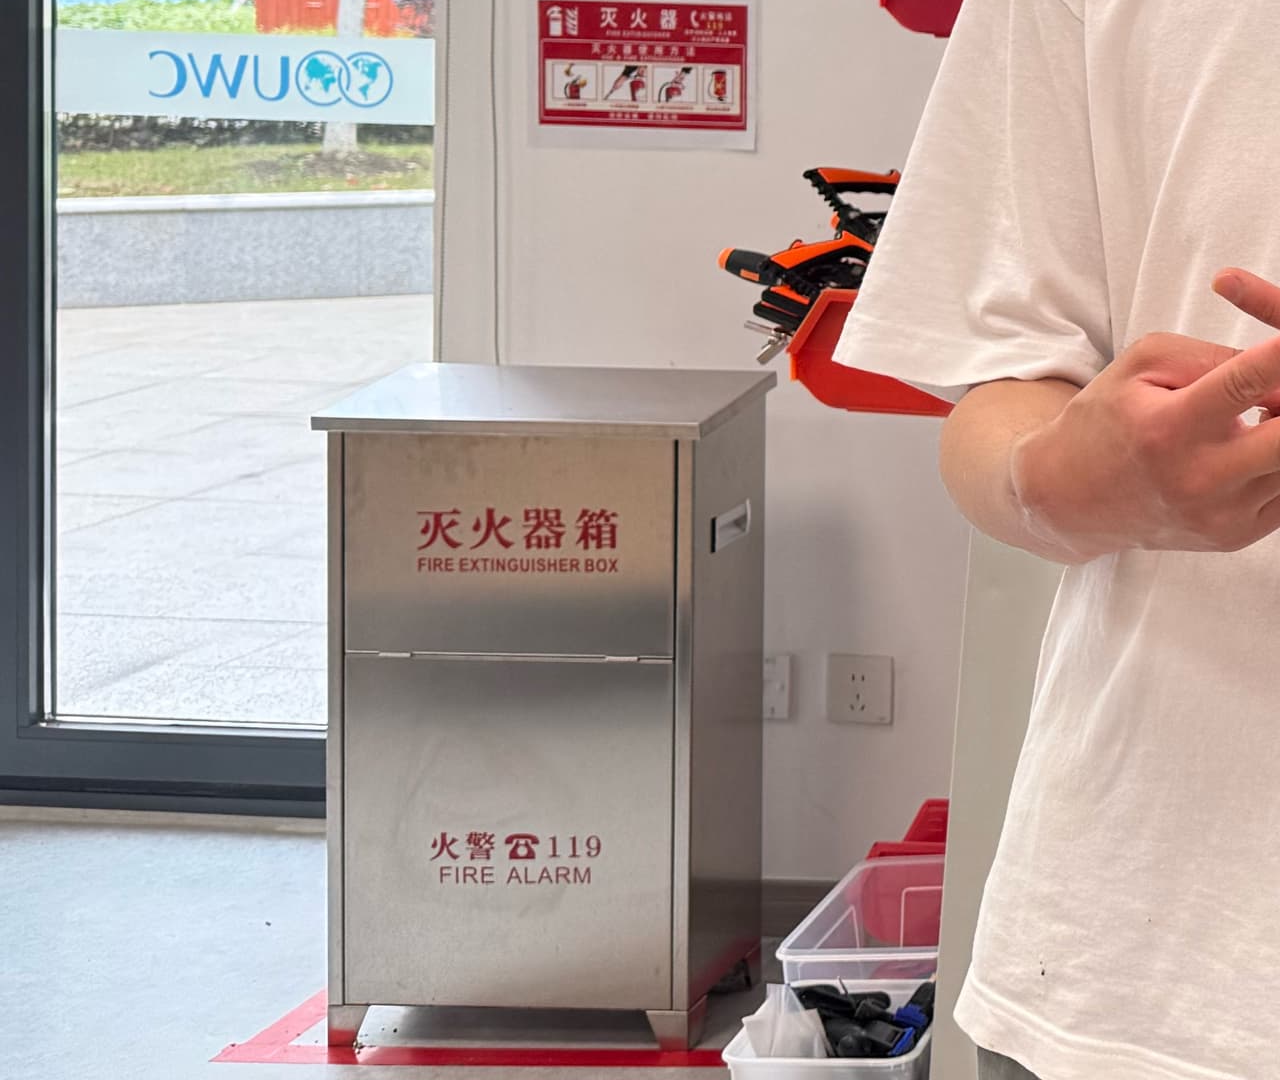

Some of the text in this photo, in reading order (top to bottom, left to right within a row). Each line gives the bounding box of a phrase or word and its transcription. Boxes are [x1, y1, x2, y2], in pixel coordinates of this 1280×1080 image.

[600, 7, 677, 30] 灭火器
[415, 507, 620, 552] 灭火器箱
[417, 558, 619, 574] FIRE EXTINGUISHER BOX
[429, 832, 496, 862] 火警
[548, 834, 602, 859] 119
[439, 866, 592, 885] FIRE ALARM
